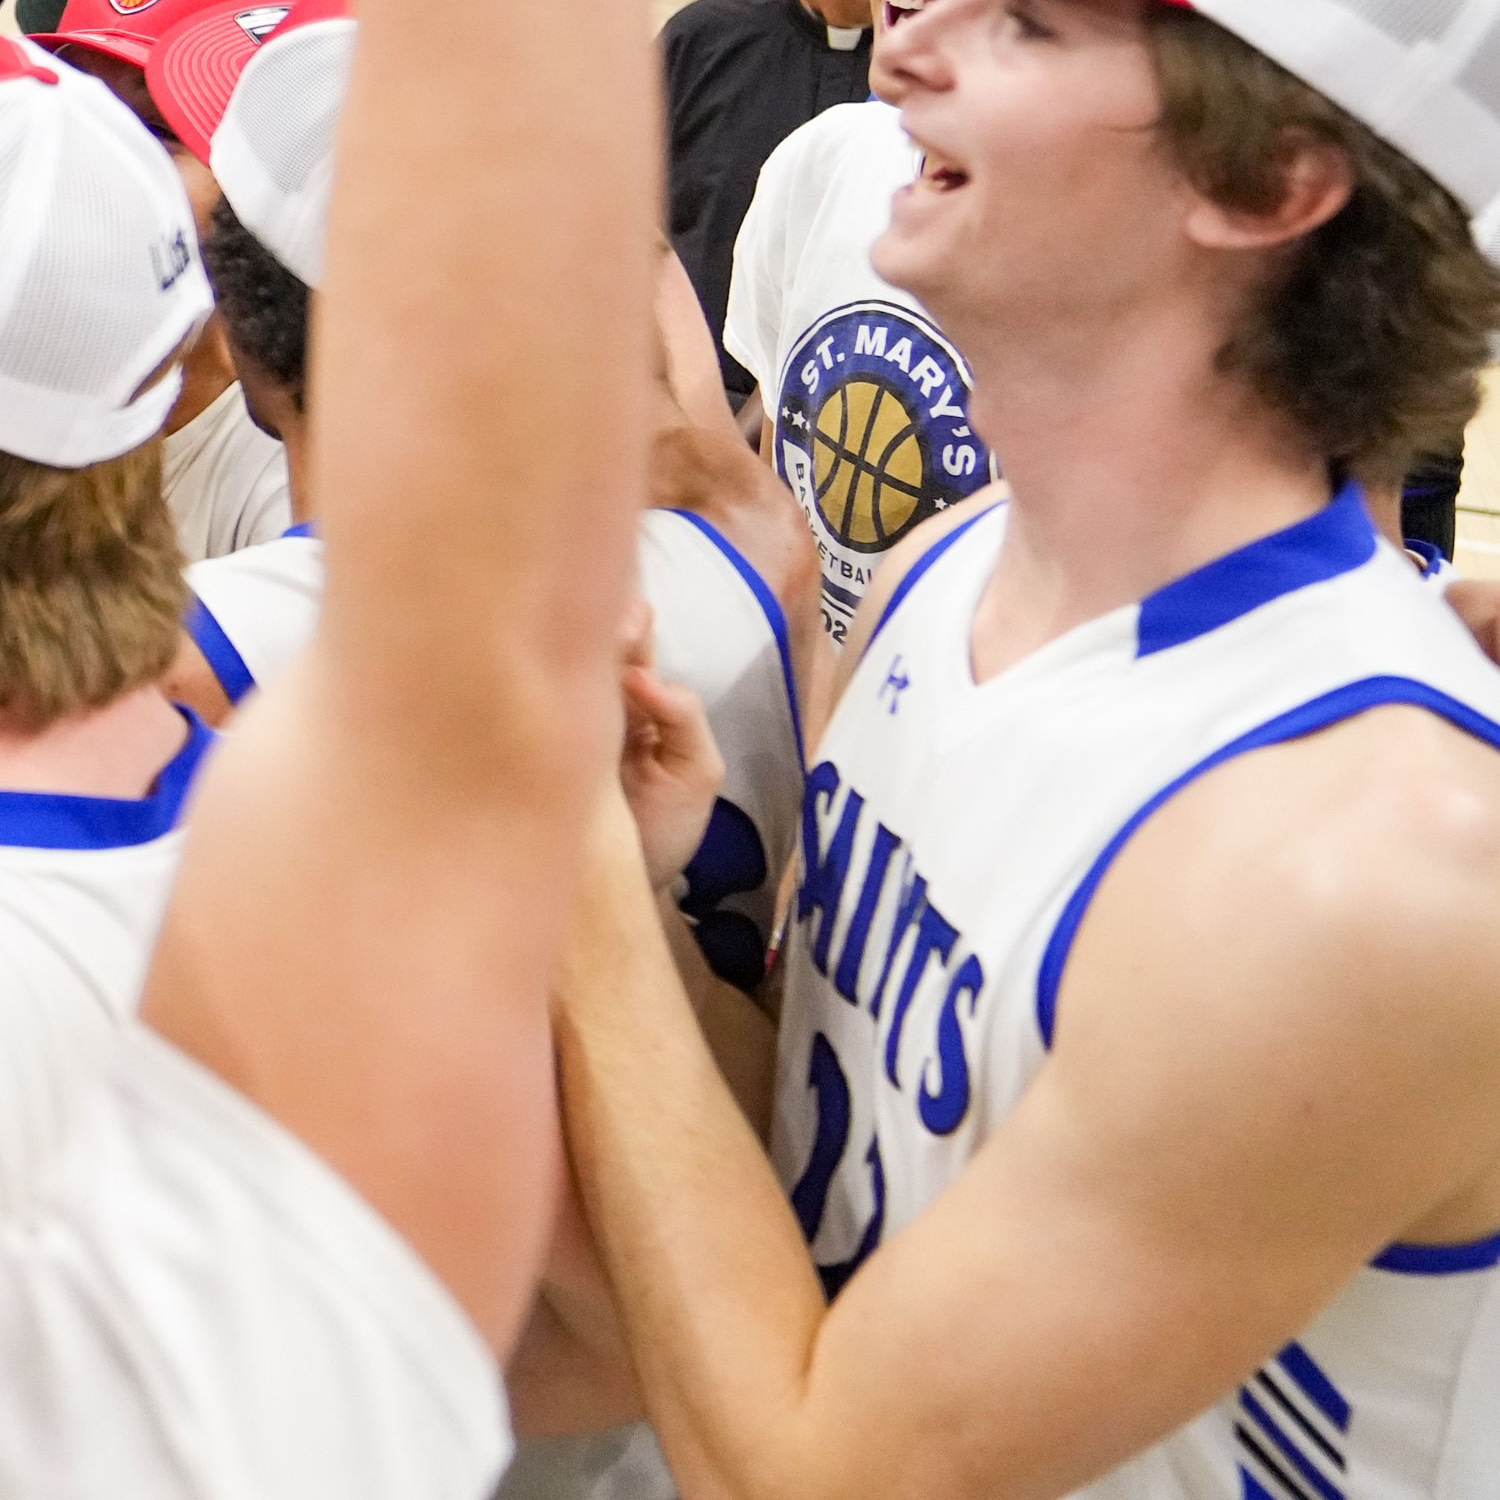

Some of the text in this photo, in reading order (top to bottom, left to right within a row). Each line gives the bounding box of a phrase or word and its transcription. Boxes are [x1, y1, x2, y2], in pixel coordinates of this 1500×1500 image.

[800, 324, 976, 478] ST. MARY'S
[796, 759, 985, 1137] SAINTS
